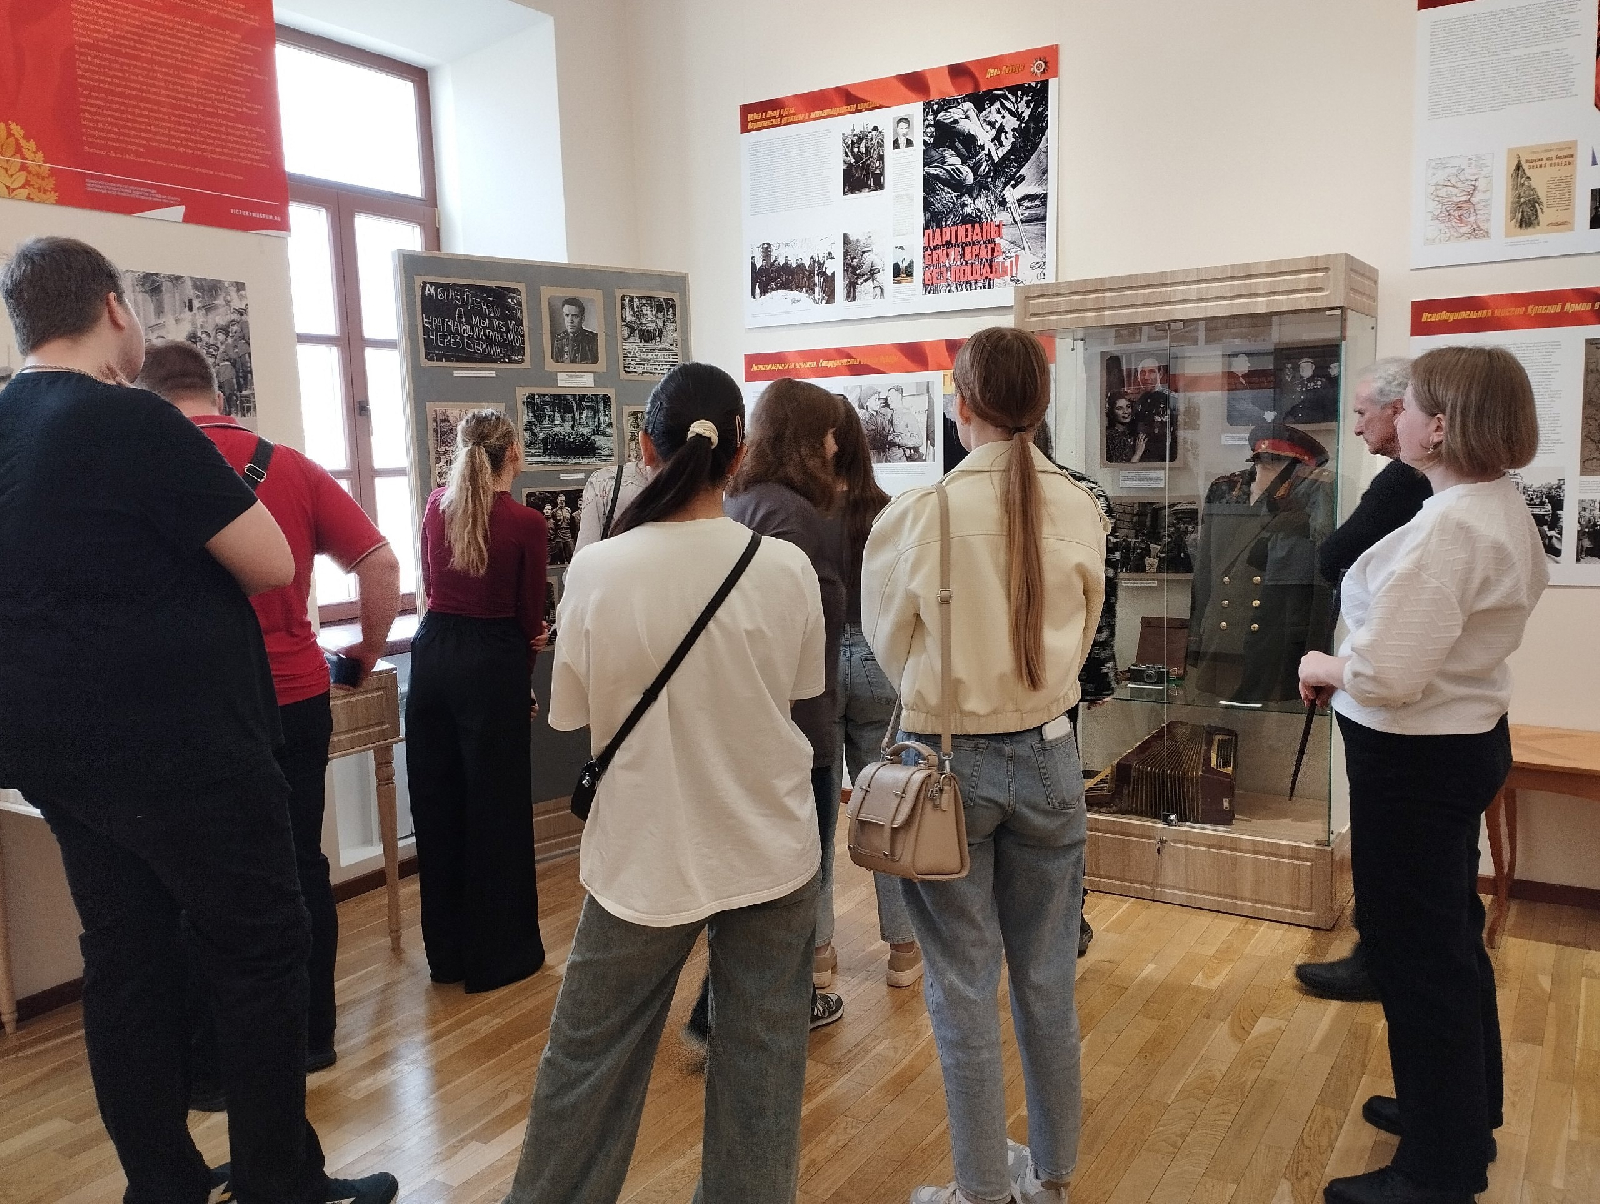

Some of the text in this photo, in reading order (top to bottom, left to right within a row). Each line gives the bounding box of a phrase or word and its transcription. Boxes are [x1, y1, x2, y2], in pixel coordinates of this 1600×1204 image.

[924, 220, 1004, 246] ПАРТИЗАНЫ
[924, 243, 1003, 265] БЕЙТЕ ВРАГА
[924, 254, 1020, 285] БЕЗ ПОЩАДЫ!
[1527, 302, 1562, 317] Красной
[430, 330, 463, 349] ЧЕРЕЗ
